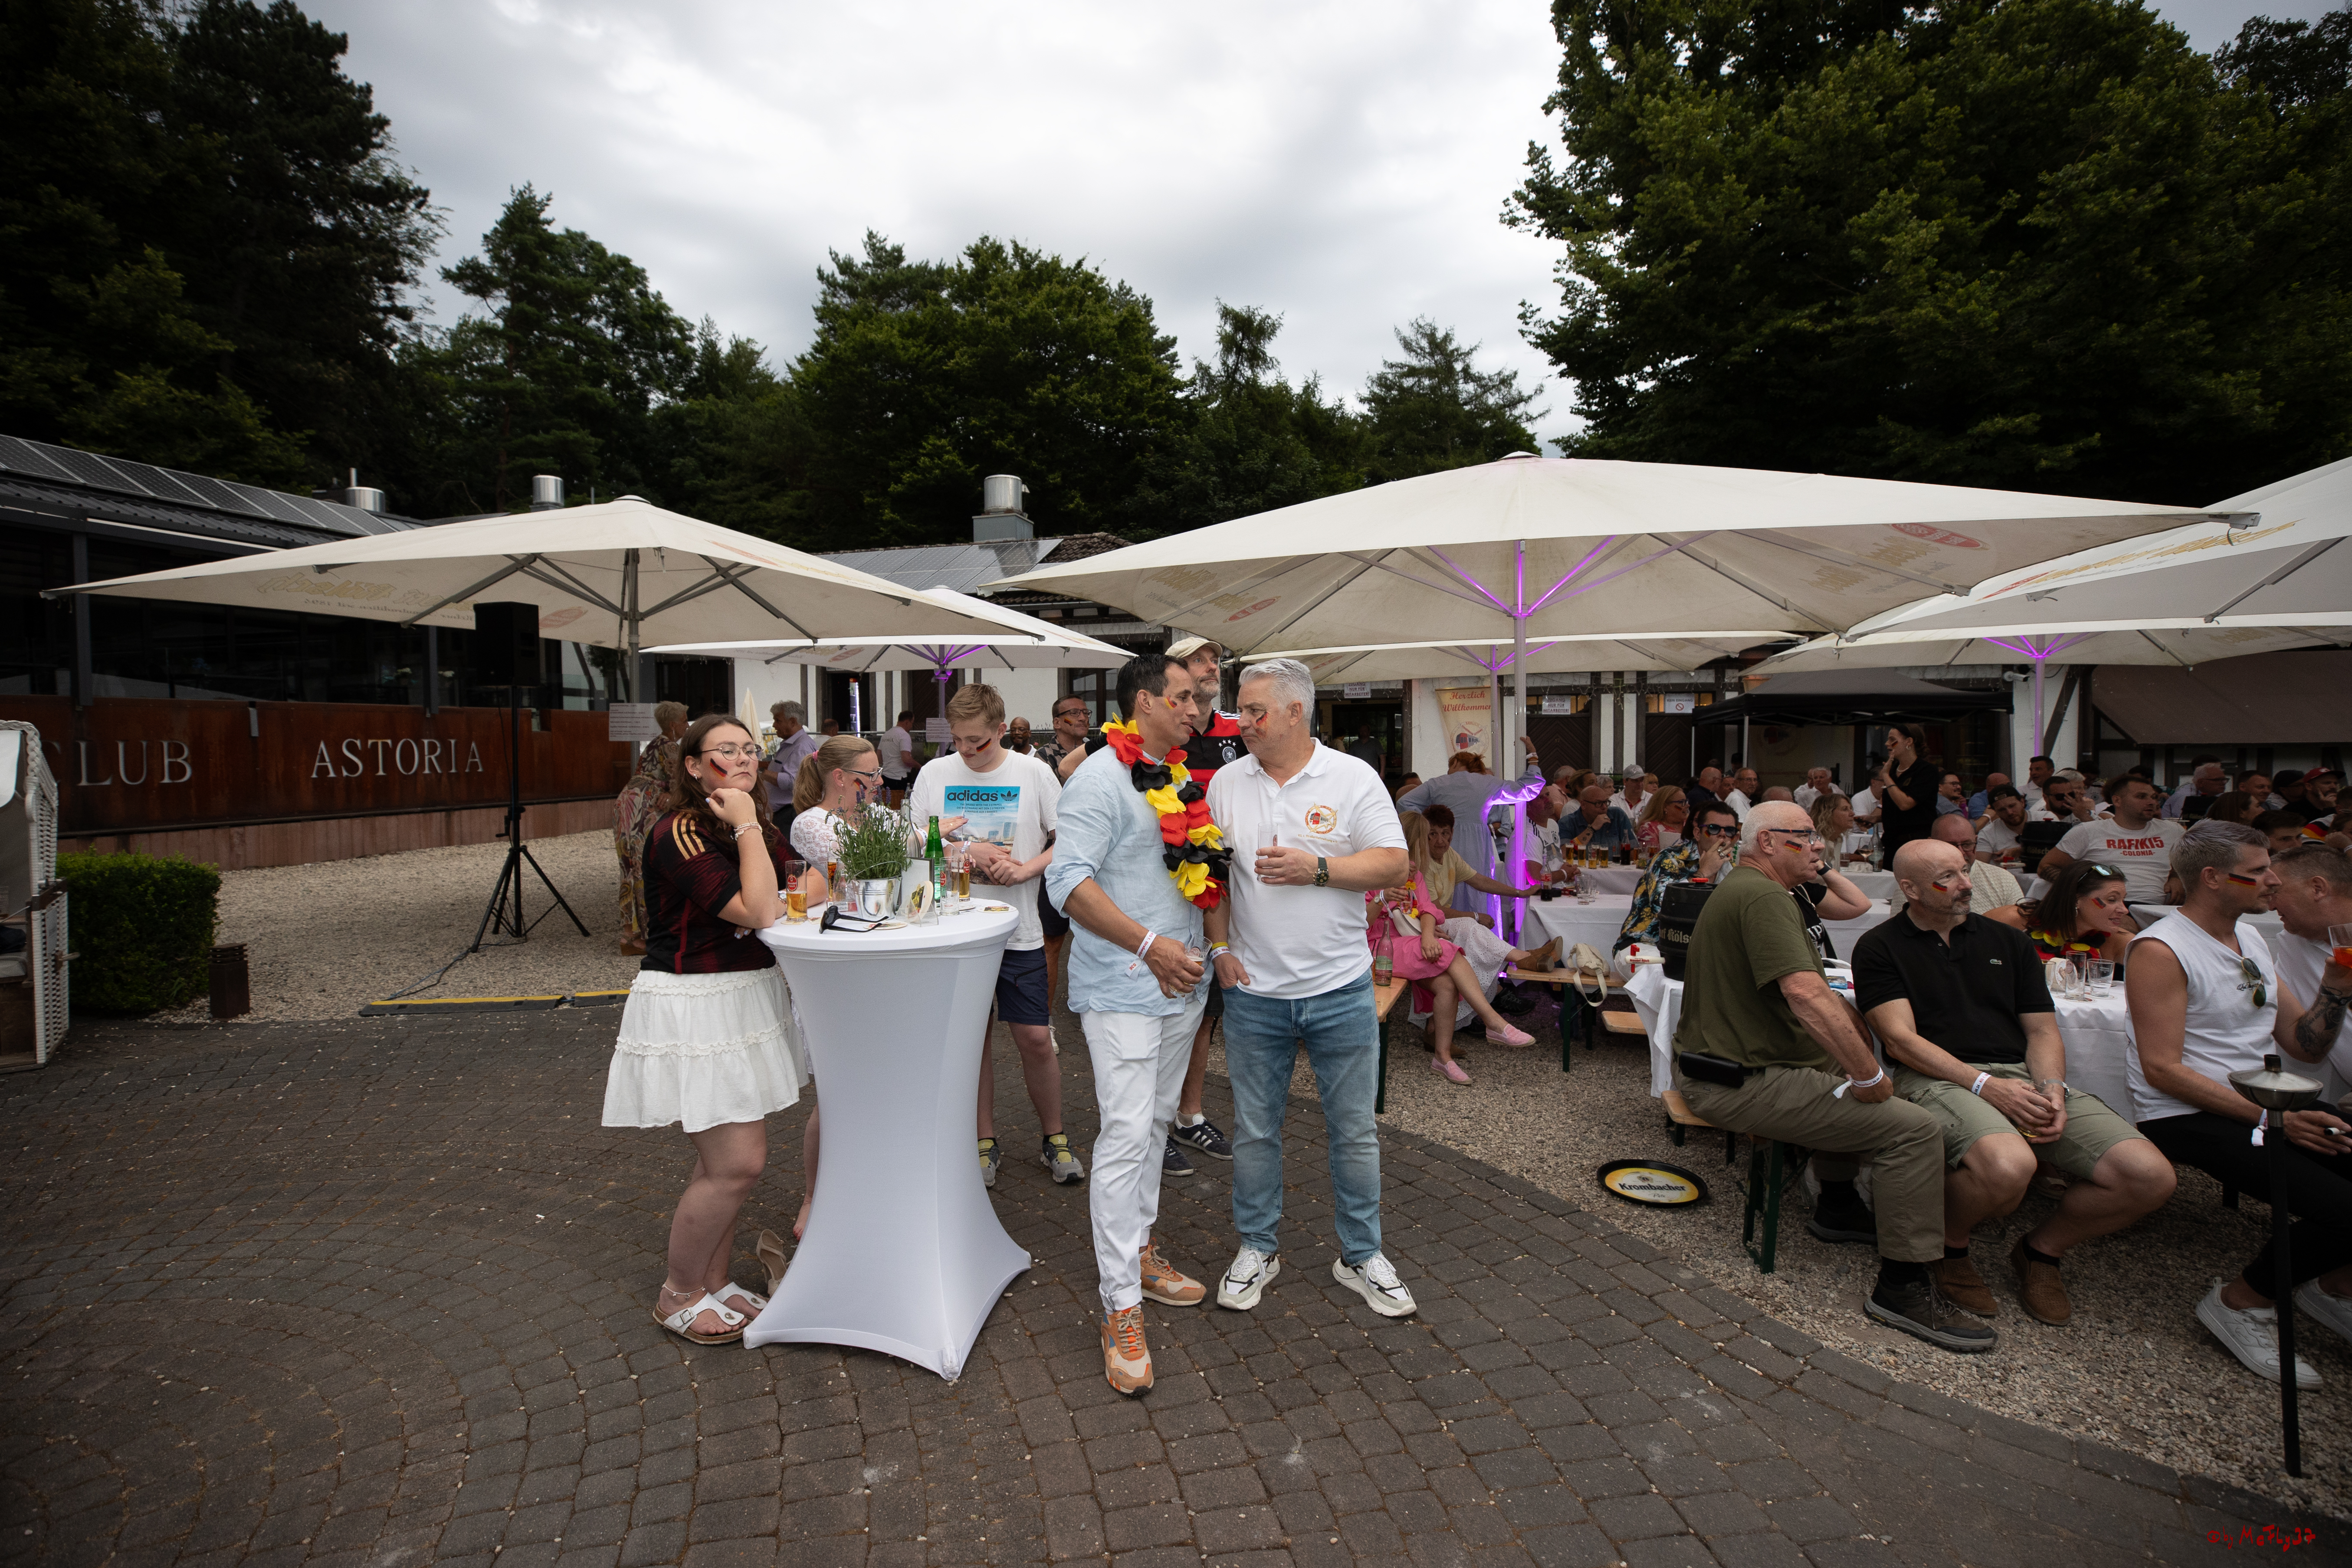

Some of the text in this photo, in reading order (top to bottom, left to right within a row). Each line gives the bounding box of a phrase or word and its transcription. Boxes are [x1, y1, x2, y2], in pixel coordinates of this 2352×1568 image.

[1450, 690, 1486, 700] Herzlich
[310, 738, 484, 778] ASTORIA
[947, 790, 998, 802] adidas
[2106, 836, 2165, 850] RAFIKI5
[1667, 928, 1692, 944] Köls
[1618, 1182, 1686, 1191] Krombacher
